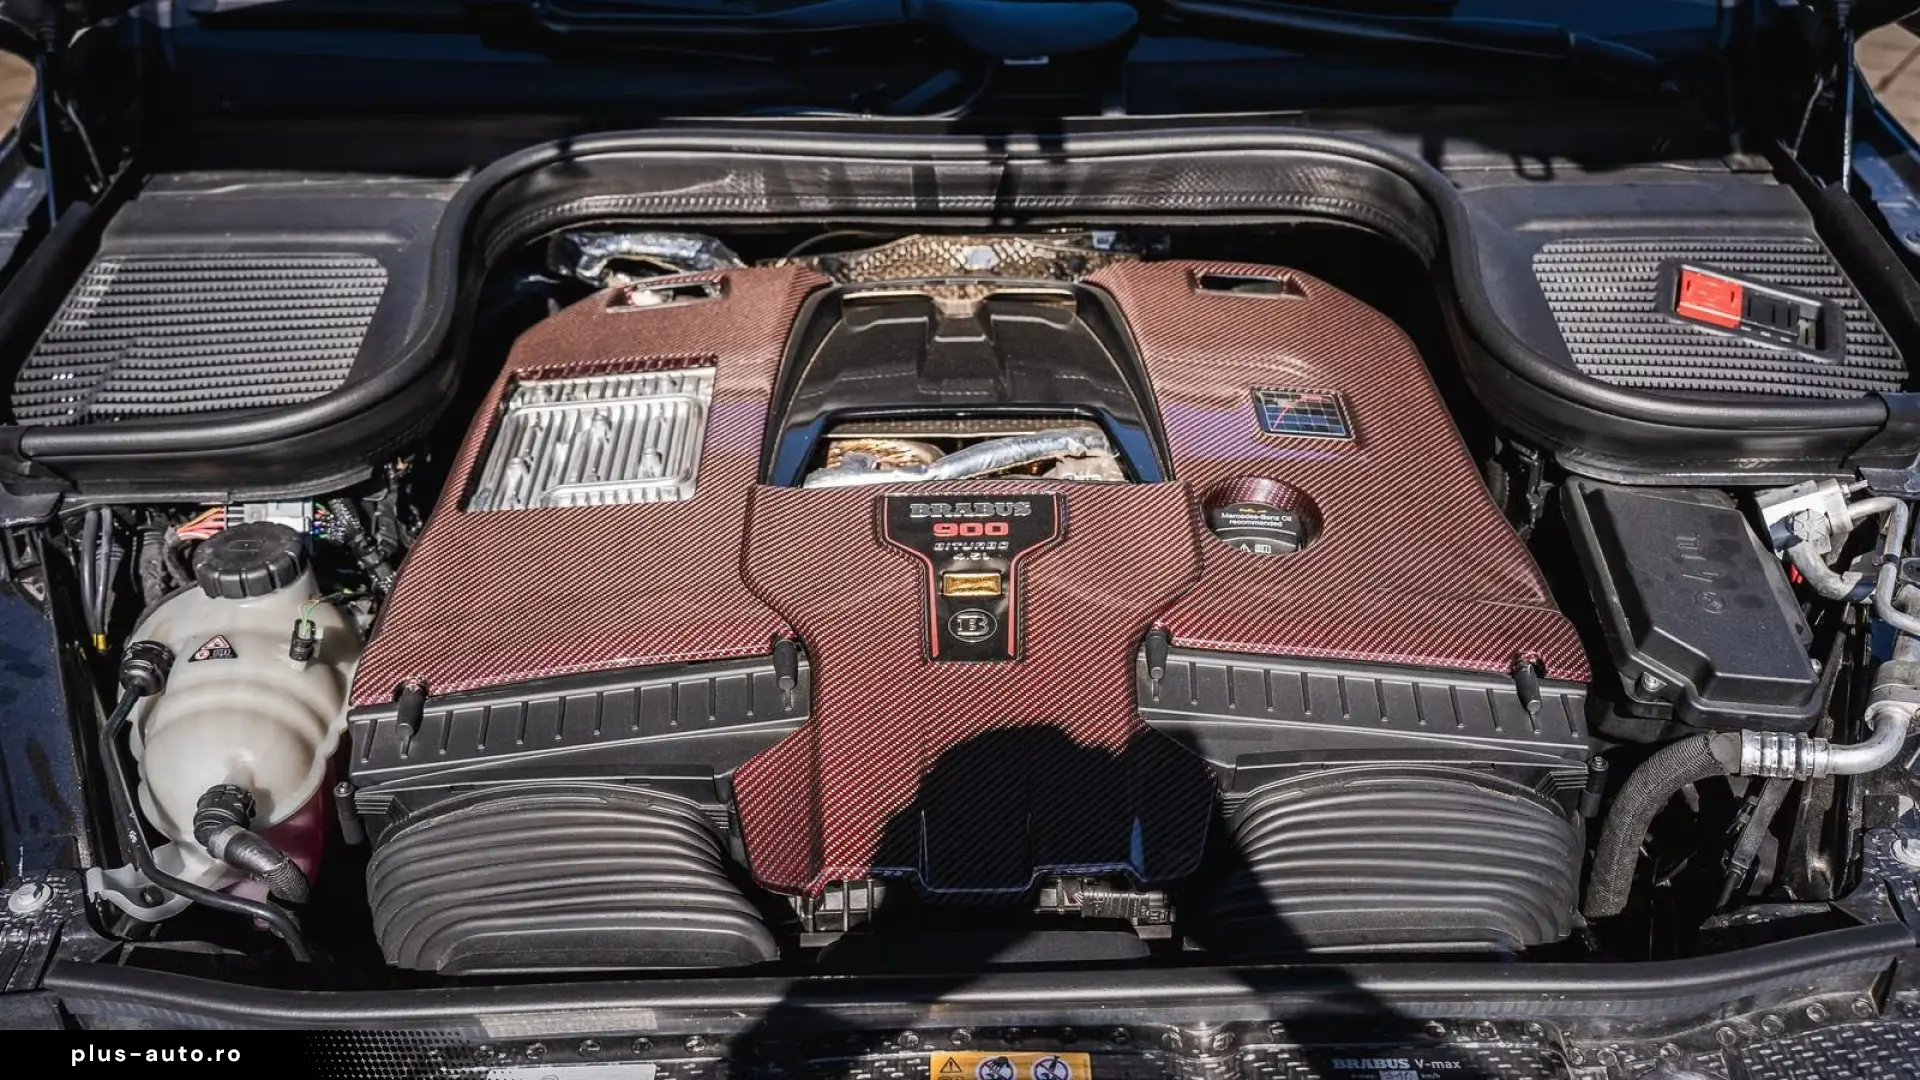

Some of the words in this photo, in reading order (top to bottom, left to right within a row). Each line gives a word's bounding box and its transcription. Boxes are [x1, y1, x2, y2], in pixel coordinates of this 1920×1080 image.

[910, 502, 1032, 518] BRABUS
[1221, 512, 1280, 521] Mercedes-Benz
[1229, 519, 1283, 527] recommended
[933, 522, 1009, 537] 900
[1332, 1058, 1411, 1070] BRABUS
[1414, 1058, 1462, 1070] V-max
